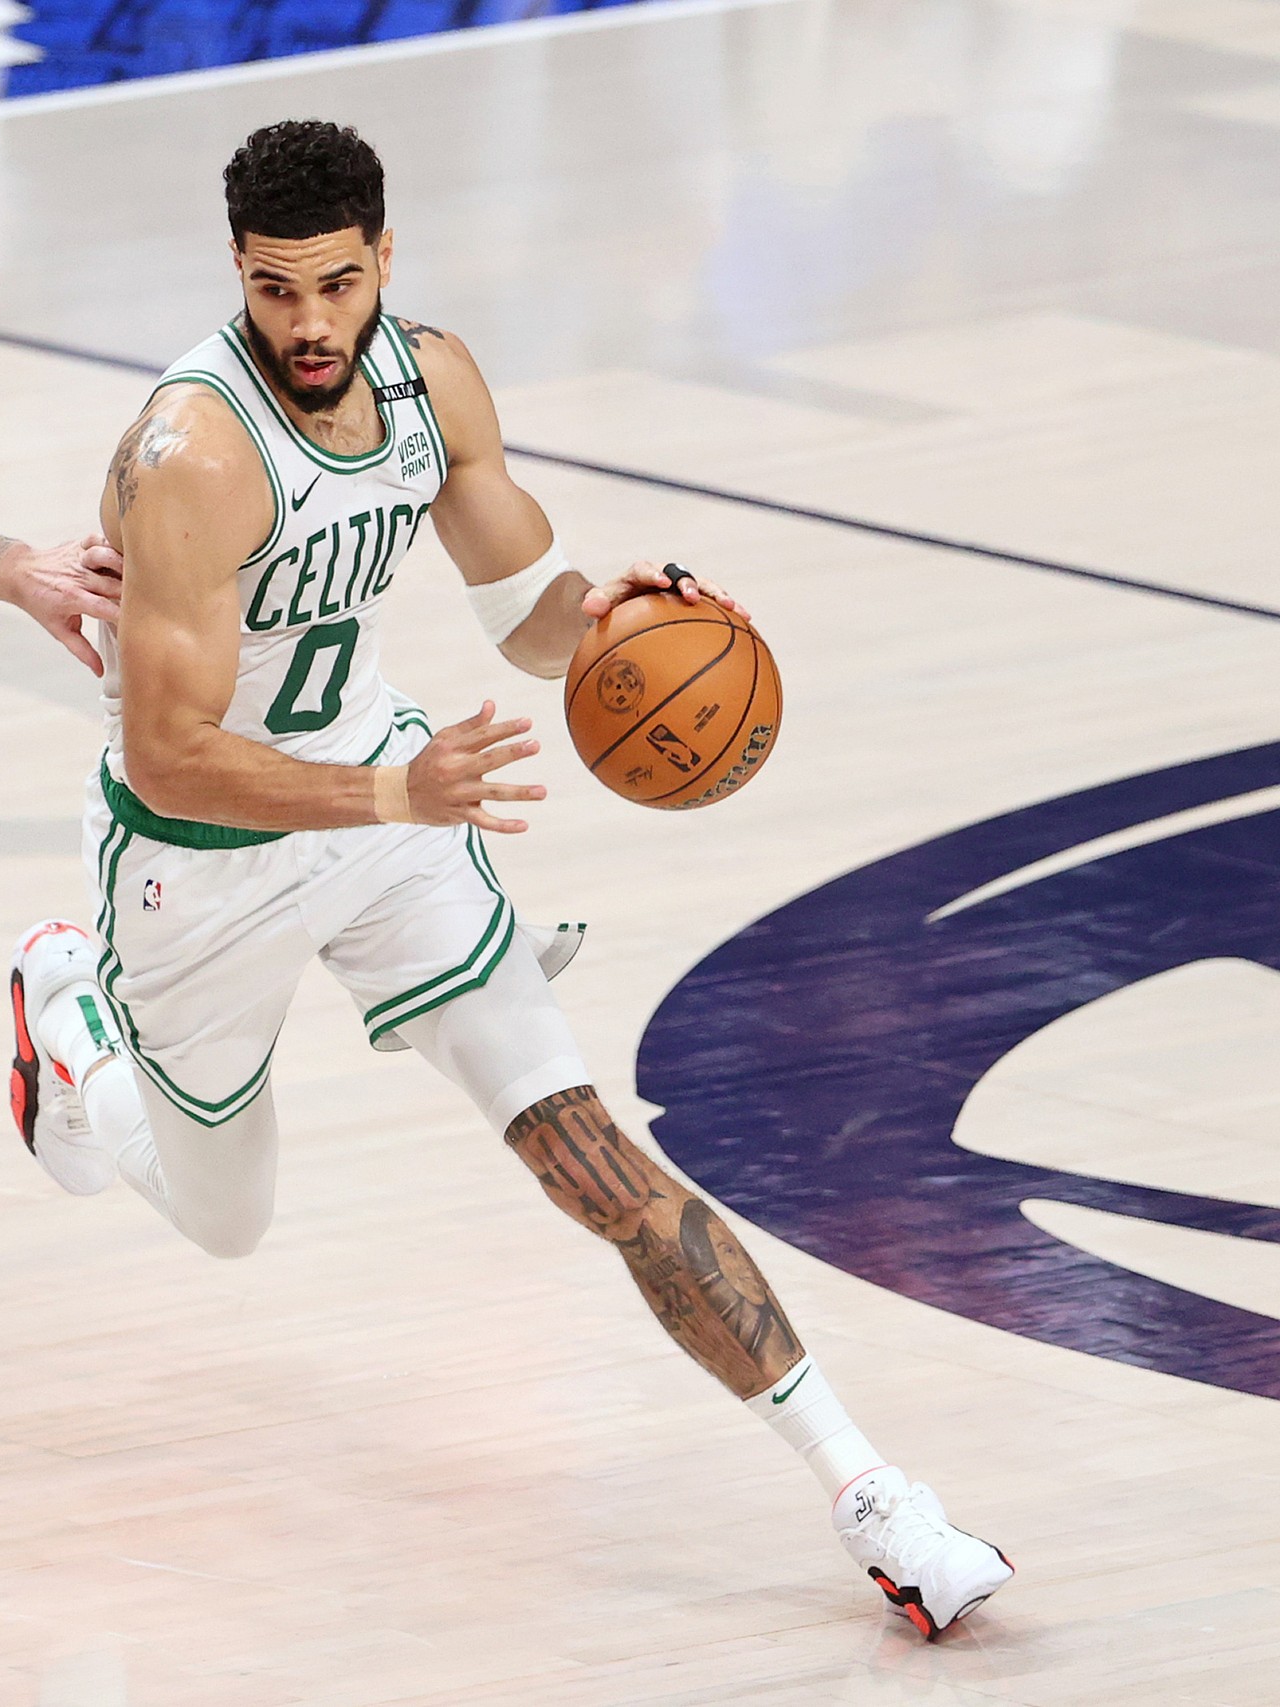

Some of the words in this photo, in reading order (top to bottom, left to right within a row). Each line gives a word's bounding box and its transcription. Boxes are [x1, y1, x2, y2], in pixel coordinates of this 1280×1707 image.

[398, 432, 429, 464] VISTA
[401, 453, 430, 482] PRINT
[264, 617, 360, 735] 0
